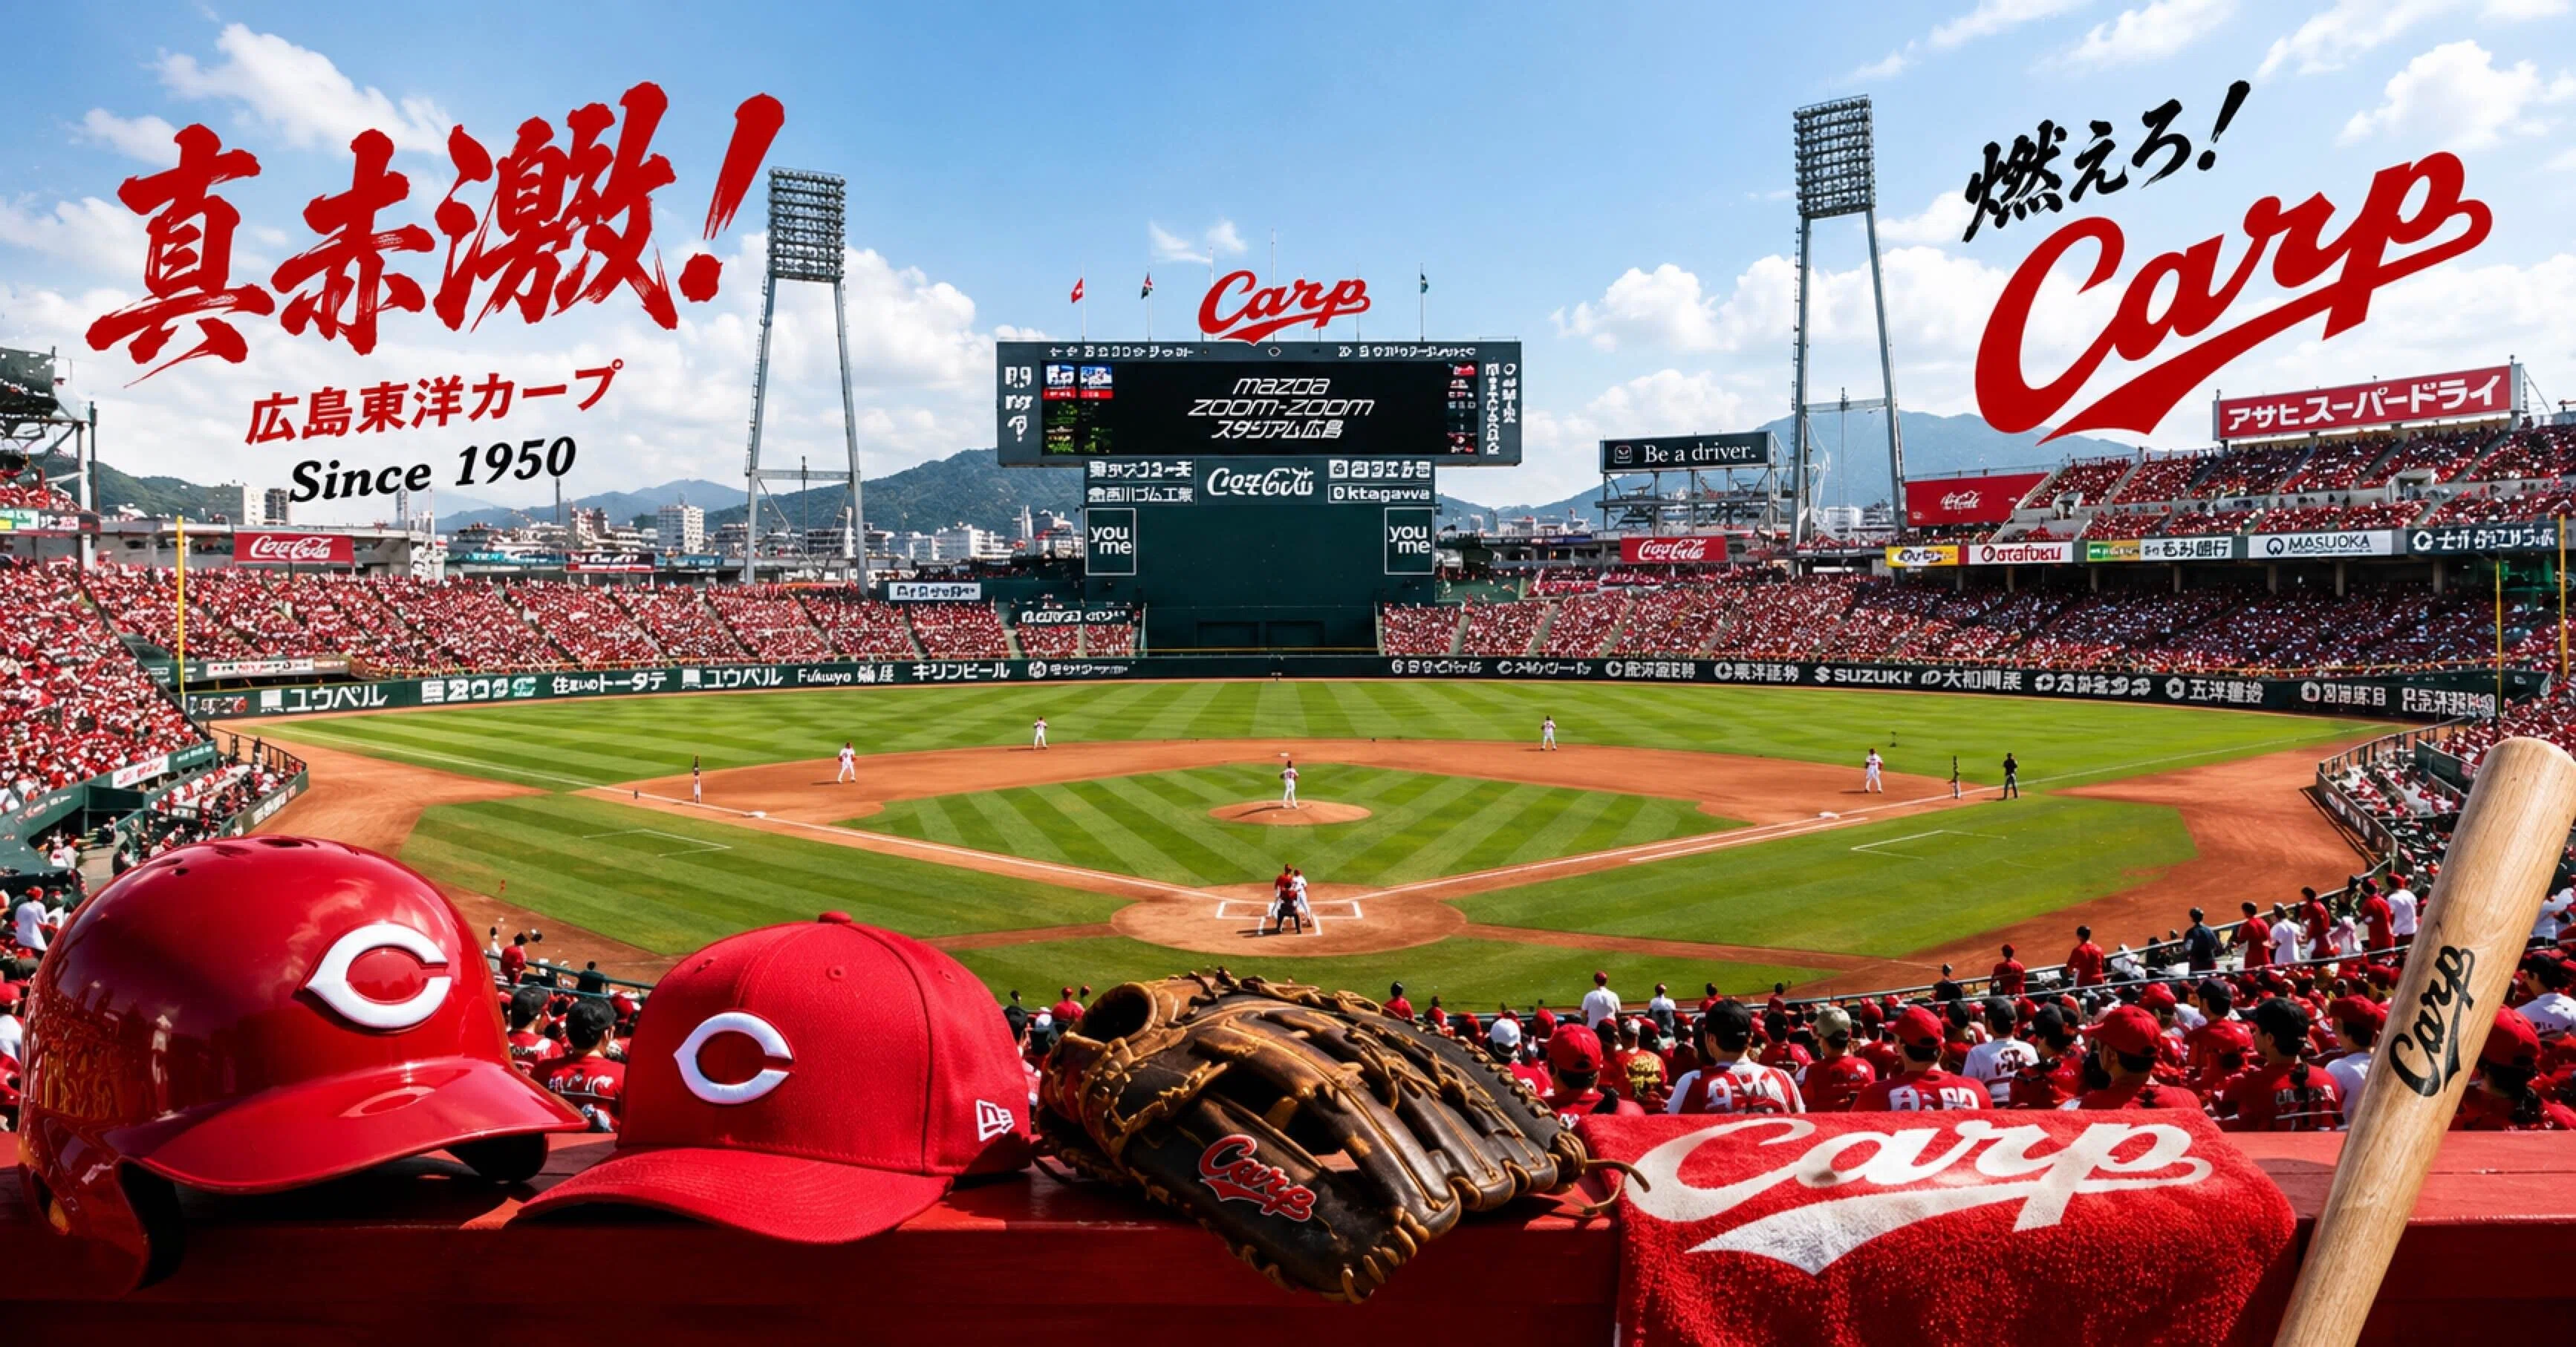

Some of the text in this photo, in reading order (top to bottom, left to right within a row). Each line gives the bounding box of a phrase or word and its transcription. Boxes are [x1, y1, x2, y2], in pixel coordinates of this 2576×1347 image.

[1198, 270, 1370, 345] Carp
[1644, 442, 1757, 463] Be a driver.
[1090, 525, 1129, 543] you
[1099, 539, 1133, 555] me
[1389, 525, 1428, 543] you
[1397, 539, 1431, 554] me
[2287, 533, 2371, 550] MASUOKA
[305, 923, 452, 1029] C
[2389, 945, 2476, 1098] Carp
[673, 1011, 793, 1104] C
[1198, 1134, 1317, 1222] Carp
[1623, 1115, 2213, 1275] Carp
